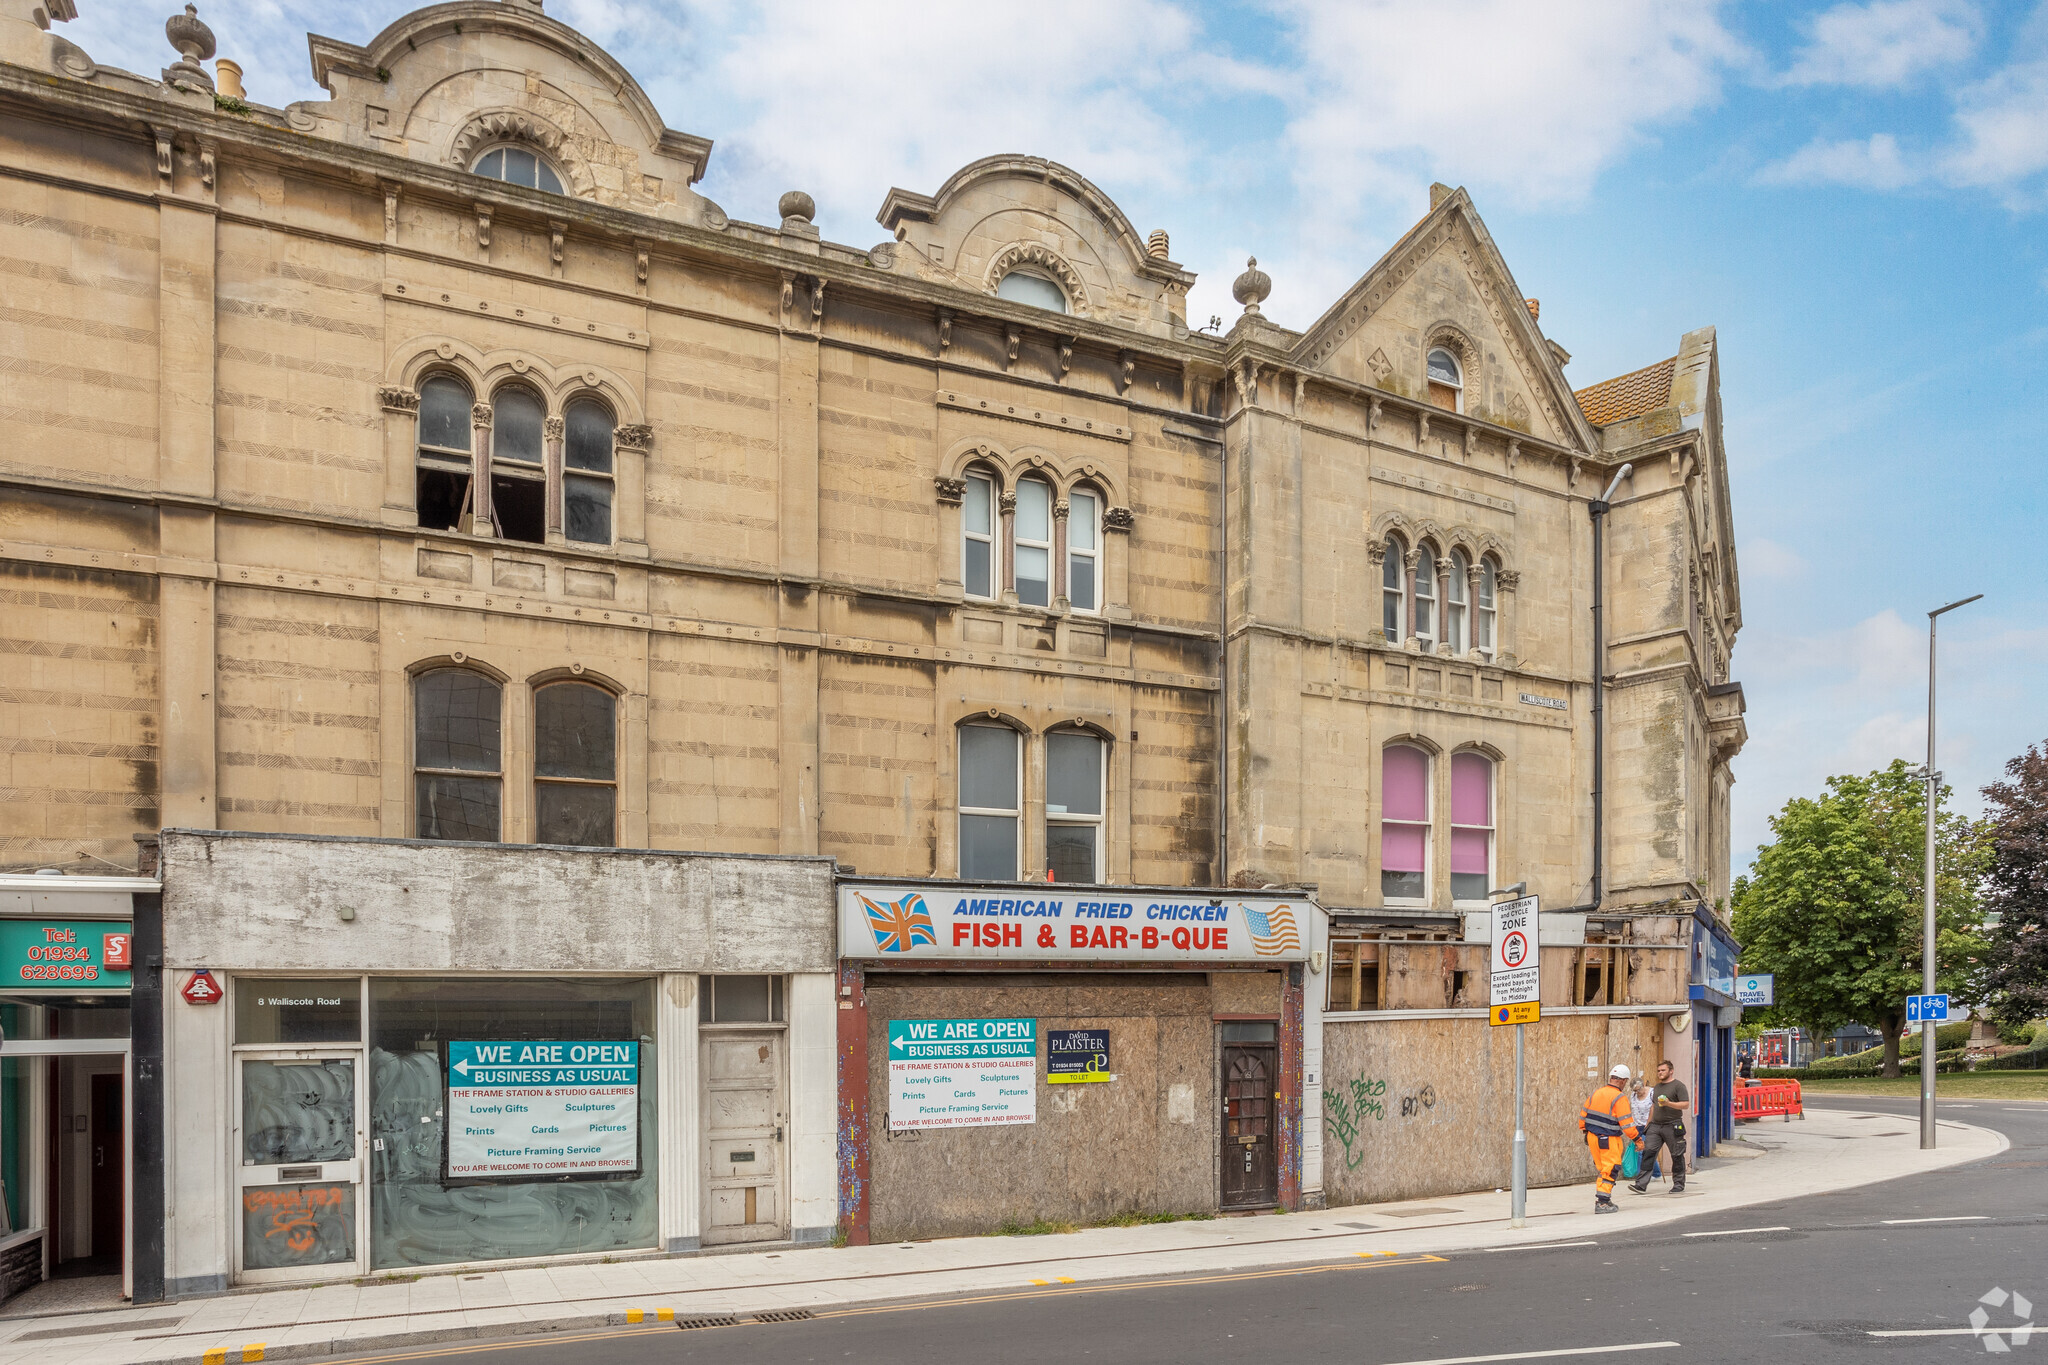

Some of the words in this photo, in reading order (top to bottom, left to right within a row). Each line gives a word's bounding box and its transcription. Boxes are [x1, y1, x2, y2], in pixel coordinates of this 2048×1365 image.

[1521, 694, 1552, 706] WALLISCOTE
[1553, 699, 1566, 708] ROAD
[953, 899, 1063, 916] AMERICAN
[1075, 902, 1133, 919] FRIED
[1147, 904, 1228, 921] CHICKEN
[1498, 900, 1531, 912] PEDESTRIAN
[1511, 908, 1528, 917] CYCLE
[1502, 917, 1526, 930] ZONE
[43, 928, 76, 943] Tel:
[953, 923, 1021, 948] FISH
[1037, 924, 1056, 948] &
[1071, 925, 1228, 951] BAR-B-QUE
[28, 946, 89, 961] 01934
[20, 965, 98, 980] 628695
[1511, 971, 1530, 980] loading
[1510, 985, 1533, 994] Midnight
[1509, 992, 1527, 1001] Midday
[909, 1024, 937, 1038] WE
[943, 1023, 977, 1038] ARE
[984, 1023, 1030, 1037] OPEN
[1052, 1039, 1104, 1050] PLAISTER
[475, 1046, 511, 1063] WE
[519, 1046, 562, 1062] ARE
[571, 1046, 629, 1062] OPEN
[909, 1045, 969, 1056] BUSINESS
[973, 1045, 988, 1055] AS
[992, 1044, 1030, 1054] USUAL
[475, 1071, 550, 1082] BUSINESS
[556, 1071, 575, 1082] AS
[580, 1070, 630, 1081] USUAL
[906, 1076, 930, 1084] Lovely
[933, 1075, 951, 1083] Gifts
[981, 1074, 1019, 1082] Sculptures
[506, 1089, 543, 1097] STATION
[554, 1088, 587, 1096] STUDIO
[589, 1088, 634, 1096] GALLERIES
[470, 1105, 502, 1114] Lovely
[505, 1104, 528, 1113] Gifts
[565, 1103, 615, 1112] Sculptures
[948, 1105, 979, 1113] Framing
[466, 1127, 494, 1135] Prints
[531, 1125, 559, 1134] Cards
[590, 1124, 626, 1132] Pictures
[487, 1148, 521, 1157] Picture
[525, 1147, 563, 1156] Framing
[567, 1146, 601, 1154] Service
[490, 1163, 530, 1171] WELCOME
[533, 1162, 542, 1170] TO
[545, 1161, 567, 1169] COME
